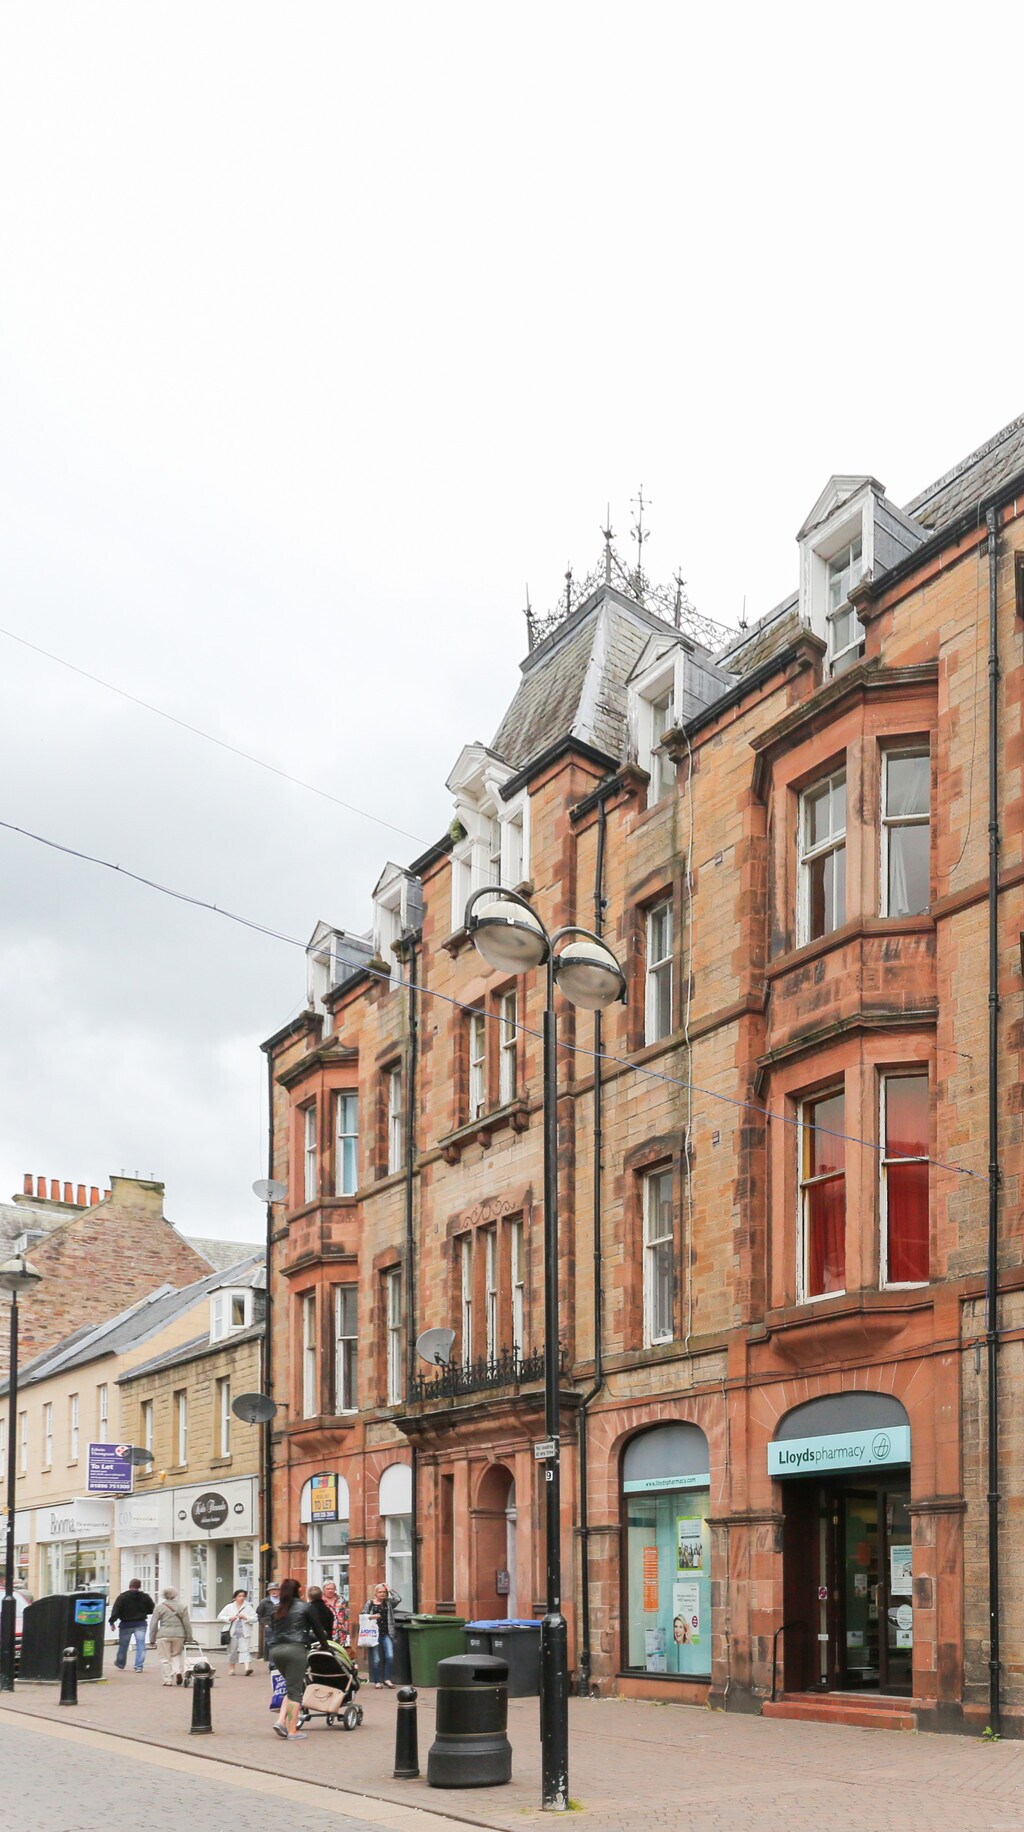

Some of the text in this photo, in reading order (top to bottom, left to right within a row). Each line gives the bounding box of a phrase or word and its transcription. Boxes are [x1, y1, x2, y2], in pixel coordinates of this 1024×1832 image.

[779, 1446, 865, 1466] Lloydspharmacy
[546, 1471, 552, 1480] 9
[645, 1477, 697, 1487] www.lloydspharmacy.com
[314, 1500, 332, 1510] TO LET
